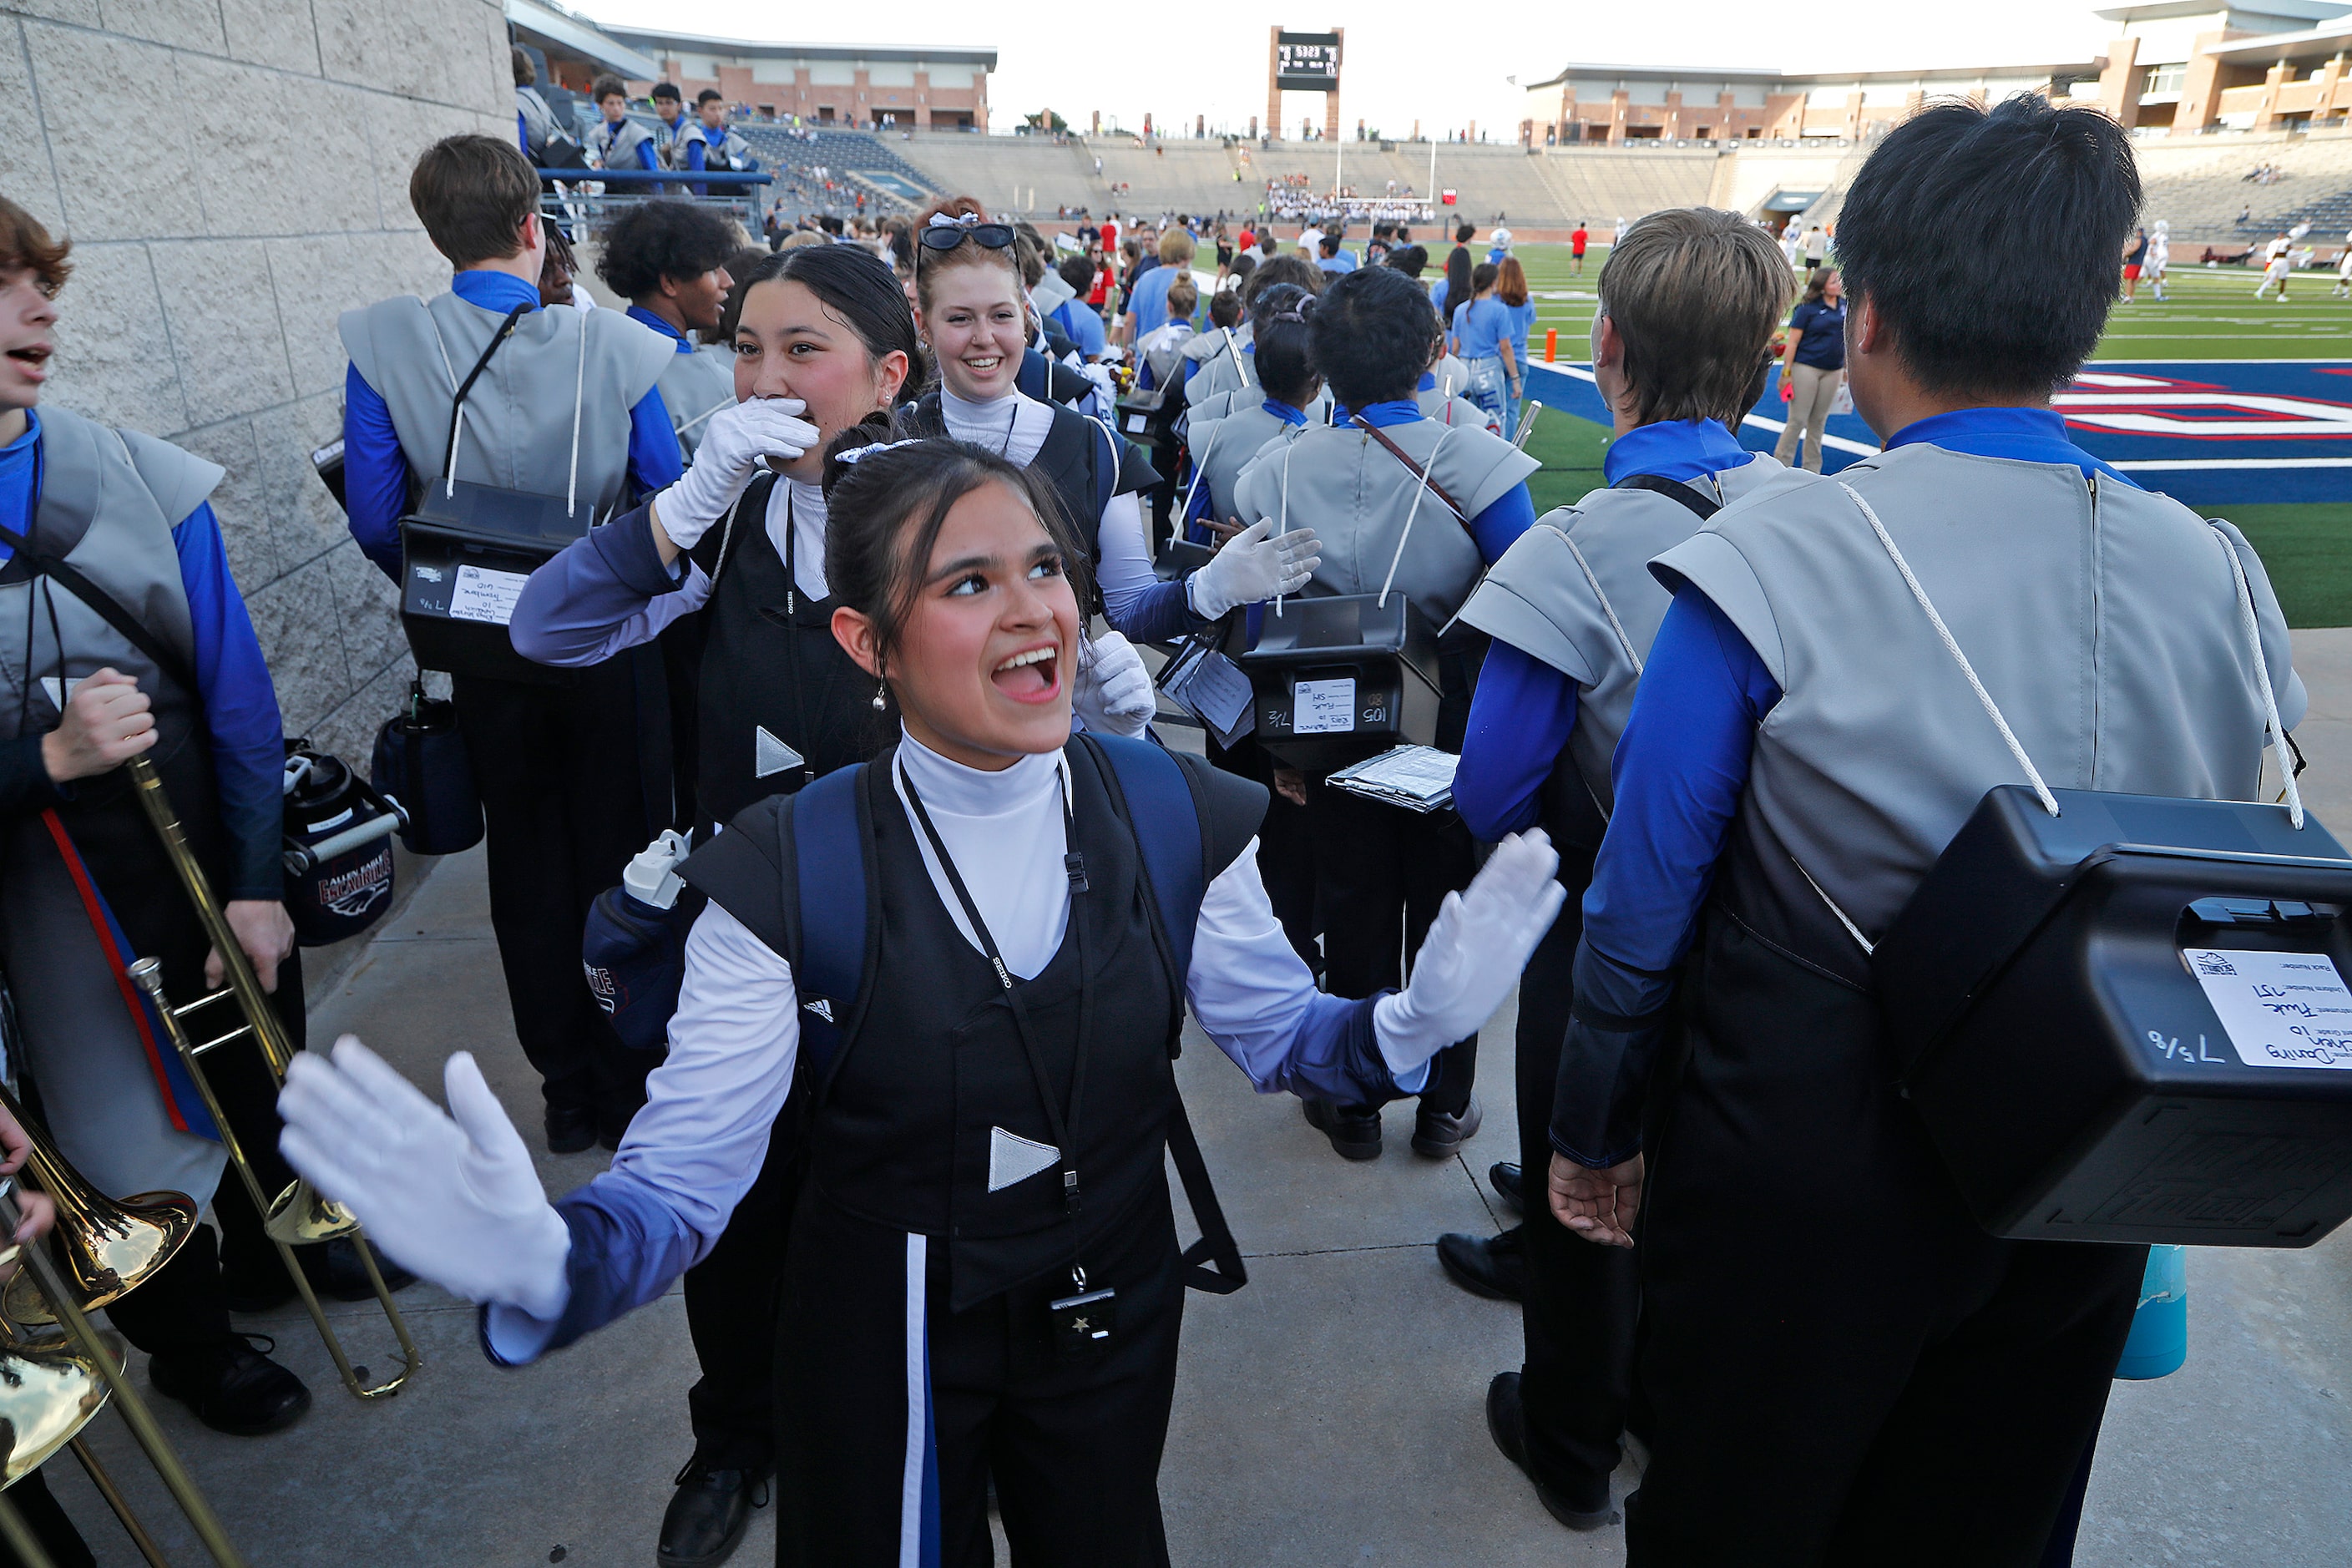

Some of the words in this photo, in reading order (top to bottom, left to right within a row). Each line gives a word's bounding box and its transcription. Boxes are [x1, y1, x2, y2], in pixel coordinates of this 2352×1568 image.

[1362, 706, 1387, 722] 105
[330, 868, 358, 886] ALLEN
[993, 957, 1012, 989] SEIKO
[2289, 1025, 2310, 1036] 10
